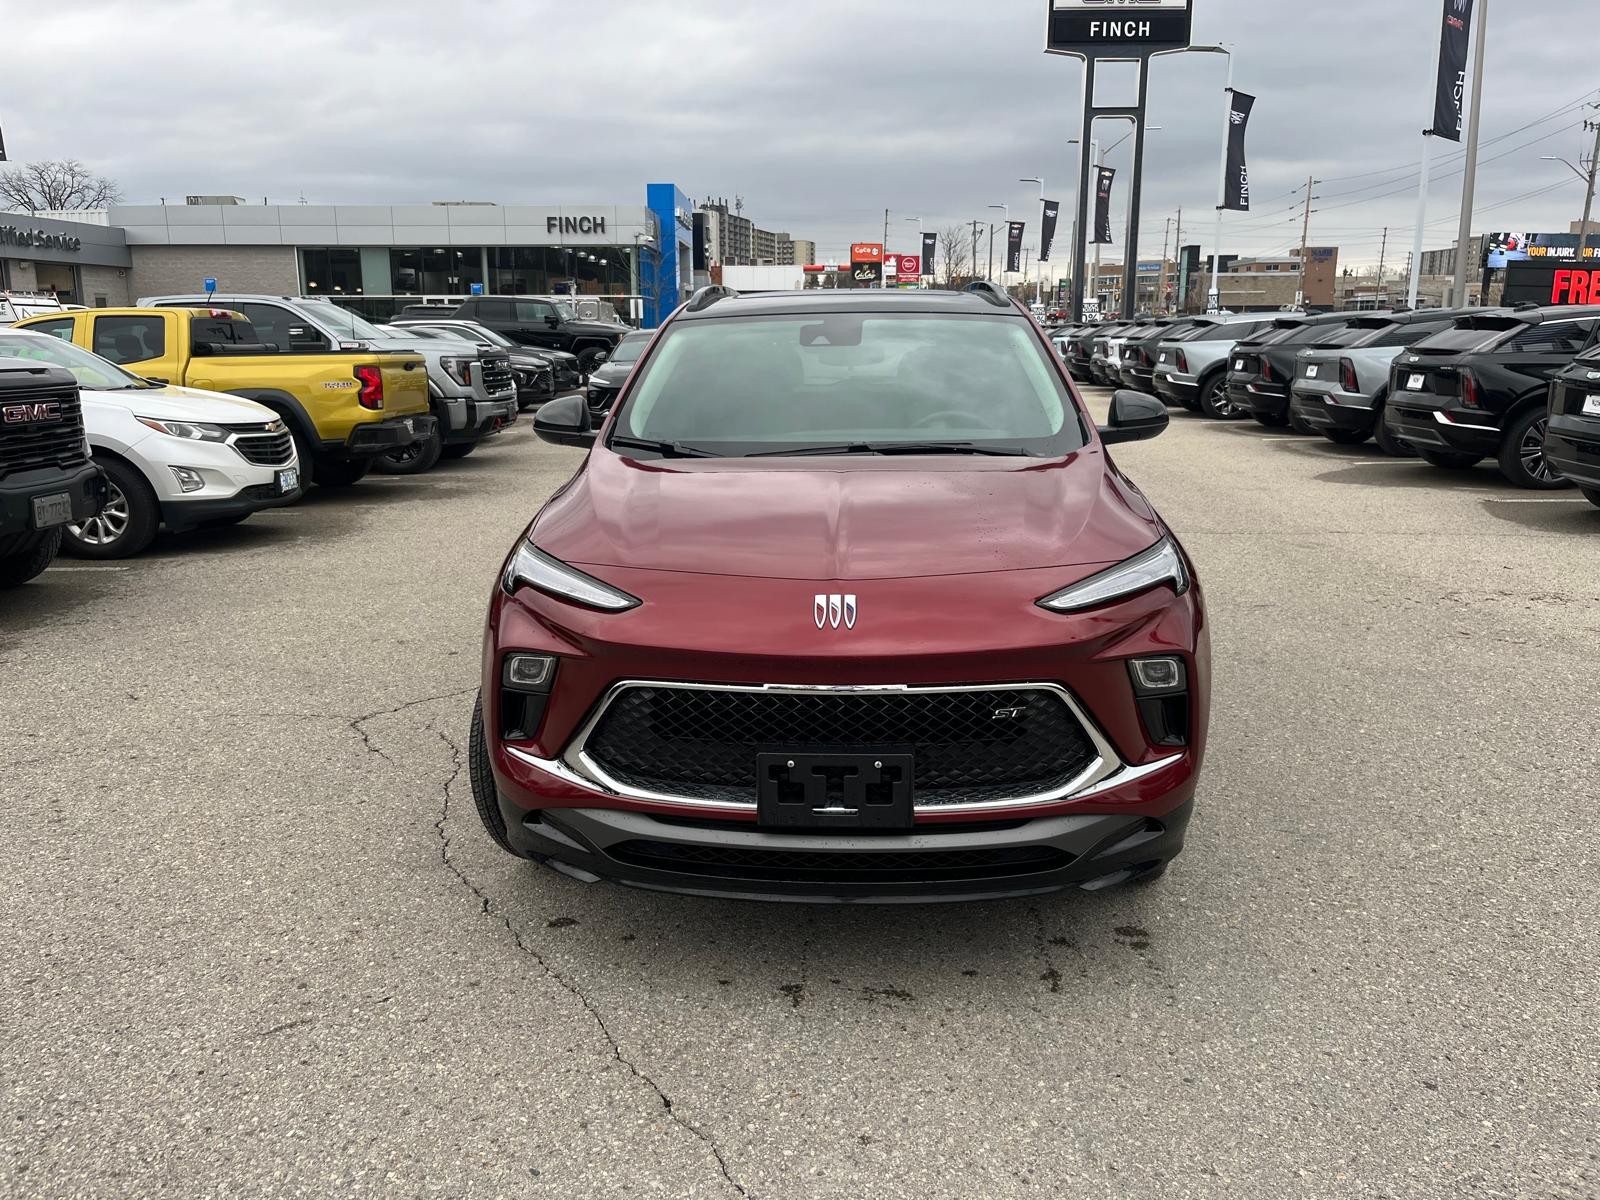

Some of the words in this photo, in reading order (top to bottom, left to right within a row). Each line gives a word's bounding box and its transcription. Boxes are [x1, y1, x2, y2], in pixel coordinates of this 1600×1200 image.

[1090, 21, 1150, 37] FINCH
[1239, 165, 1248, 206] FINCH
[547, 216, 605, 234] FINCH
[36, 230, 81, 252] Service
[1528, 246, 1546, 257] YOUR
[1546, 247, 1575, 257] INJURY.
[1582, 247, 1593, 257] UR
[1551, 269, 1600, 304] FRE
[3, 403, 62, 423] GMC
[992, 706, 1026, 719] ST
